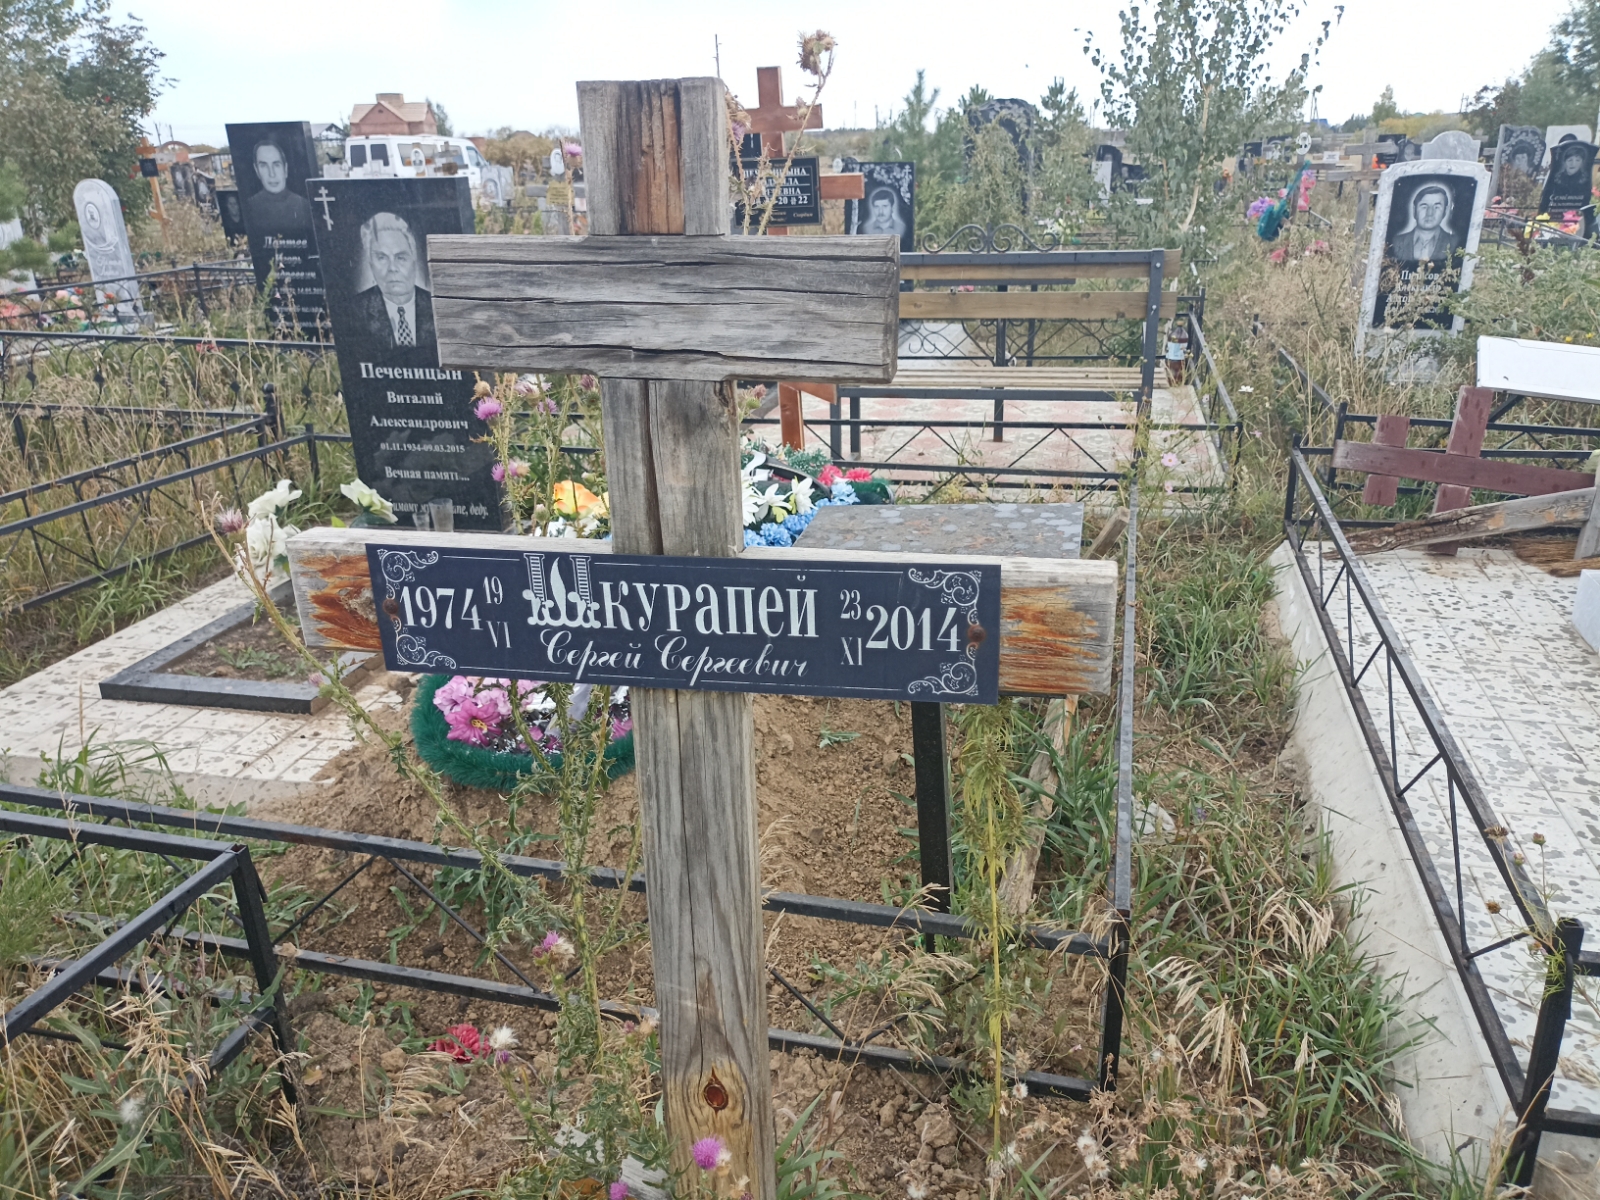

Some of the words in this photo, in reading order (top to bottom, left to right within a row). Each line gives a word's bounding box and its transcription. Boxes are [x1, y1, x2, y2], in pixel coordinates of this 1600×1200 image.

[275, 270, 317, 280] ндреевич
[359, 362, 463, 381] Печеницын
[386, 391, 444, 405] Виталий
[370, 415, 469, 431] Александрович
[380, 442, 466, 454] 01.11.1934-09.03.2015
[384, 466, 422, 480] Вечная
[391, 500, 418, 514] имому
[400, 585, 484, 631] 1974
[483, 576, 504, 605] 19
[522, 553, 819, 638] Шкурапей
[840, 589, 861, 620] 23
[865, 604, 962, 652] 2014
[486, 620, 512, 649] VI
[540, 629, 645, 681] Сергей
[655, 634, 809, 687] Сергеевич
[840, 636, 863, 666] XI
